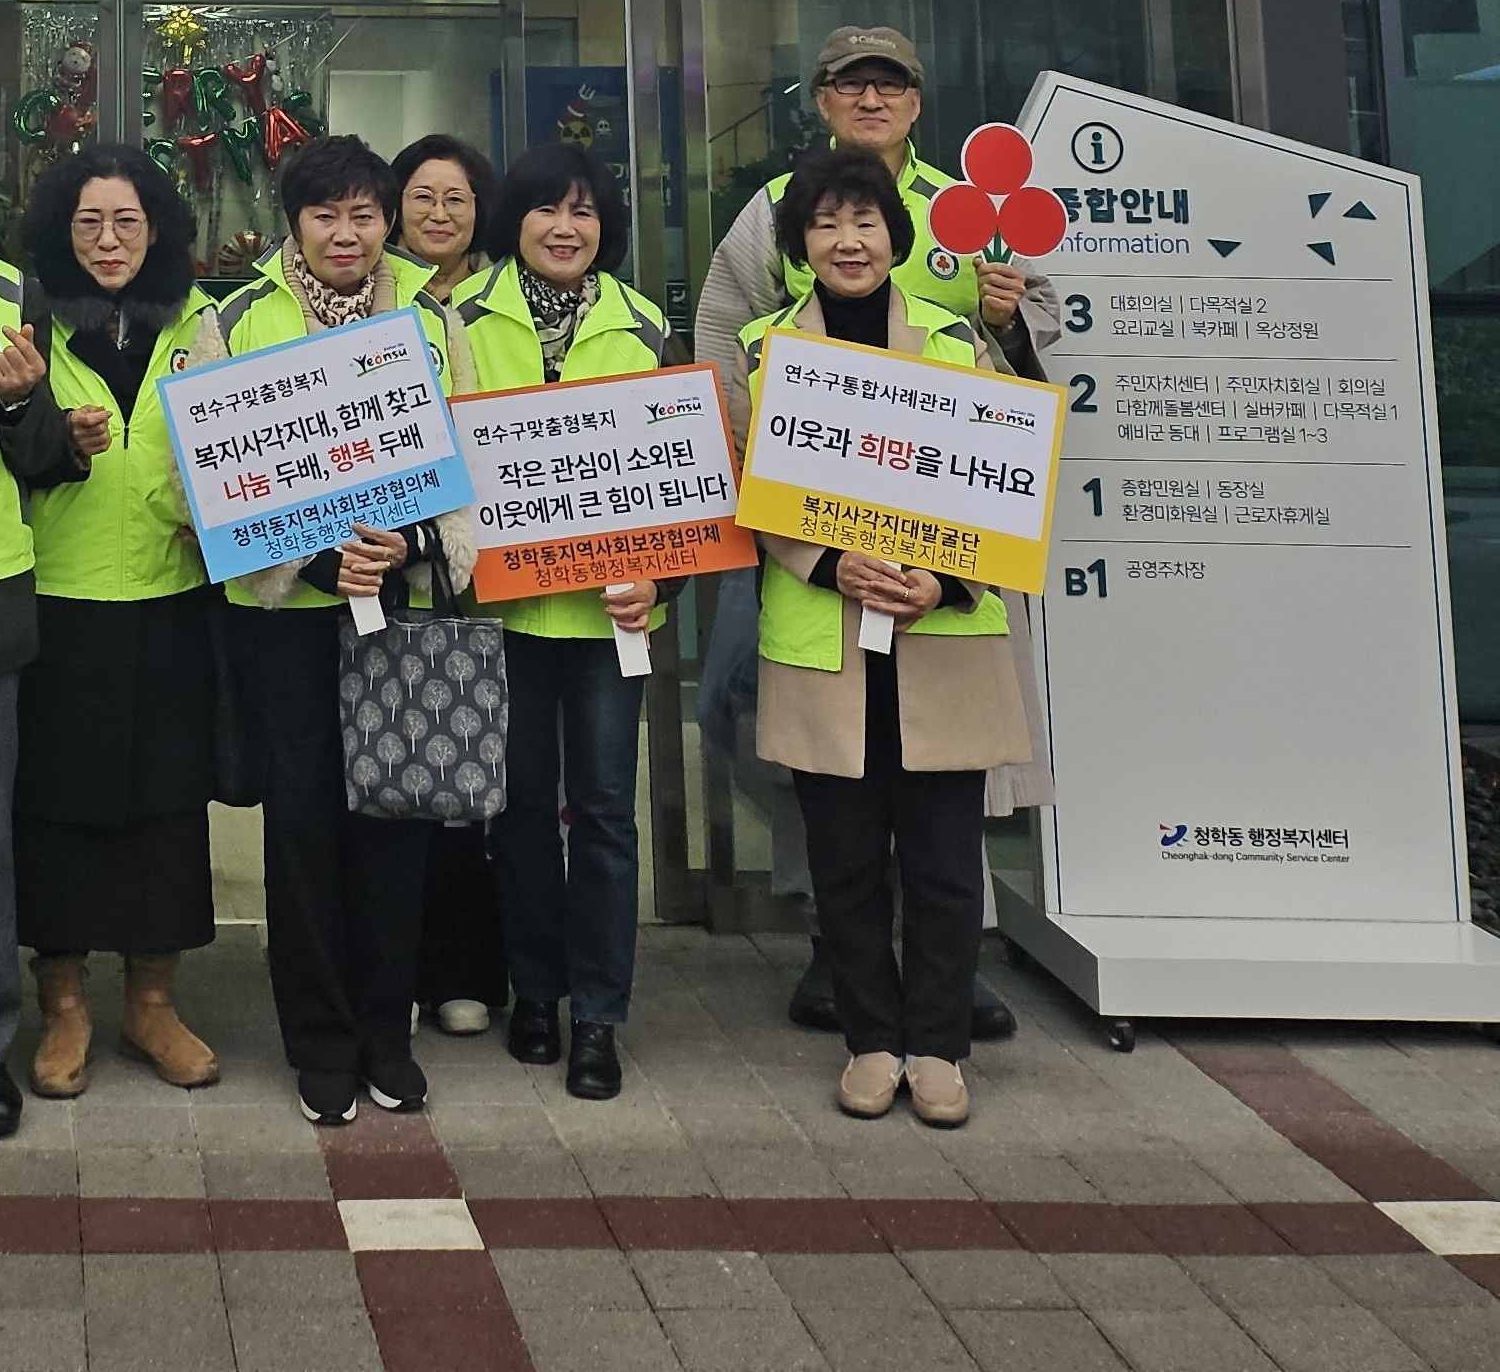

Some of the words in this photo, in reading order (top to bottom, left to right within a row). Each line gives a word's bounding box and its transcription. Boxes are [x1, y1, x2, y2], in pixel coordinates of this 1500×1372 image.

[1057, 231, 1190, 254] nformation
[1065, 294, 1093, 333] 3
[1110, 295, 1173, 314] 대회의실
[1189, 296, 1253, 314] 다목적실
[1256, 298, 1267, 314] 2
[1111, 319, 1174, 338] 요리교실
[1192, 319, 1238, 339] 북카페
[1255, 321, 1319, 340] 옥상정원
[352, 347, 407, 373] Yeonsu
[189, 367, 328, 424] 연수구맞춤형복지
[784, 364, 958, 417] 연수구통합사례관리
[1069, 374, 1098, 413] 2
[1114, 374, 1209, 394] 주민자치센터
[1225, 376, 1321, 395] 주민자치회실
[1337, 378, 1386, 396] 회의실
[1116, 399, 1226, 418] 다함께돌봄센터
[1243, 400, 1306, 420] 실버카페
[1323, 402, 1387, 421] 다목적실
[1389, 404, 1399, 421] 1
[194, 410, 338, 471] 복지사각지대,
[335, 394, 385, 431] 함께
[385, 383, 431, 417] 찾고
[473, 409, 617, 446] 연수구맞춤형복지
[644, 402, 702, 421] Yeonsu
[972, 401, 1035, 427] Yeonsu
[1118, 423, 1166, 442] 예비군
[1168, 425, 1200, 443] 동대
[1217, 426, 1296, 444] 프로그램실
[1299, 428, 1328, 444] 1~3
[223, 471, 272, 504] 나눔
[275, 453, 330, 489] 두배,
[327, 437, 375, 473] 행복
[379, 423, 425, 459] 두배
[497, 460, 547, 490] 작은
[550, 448, 621, 484] 관심이
[626, 438, 696, 472] 소외된
[770, 415, 852, 457] 이웃과
[858, 432, 944, 478] 희망을
[950, 454, 1036, 497] 나눠요
[232, 468, 441, 547] 청학동지역사회보장협의체
[479, 493, 574, 530] 이웃에게
[578, 490, 603, 518] 큰
[606, 483, 654, 515] 힘이
[658, 473, 728, 508] 됩니다
[1082, 477, 1102, 517] 1
[1121, 478, 1200, 498] 종합민원실
[1217, 480, 1265, 499] 동장실
[1122, 503, 1218, 523] 환경미화원실
[1234, 506, 1331, 526] 근로자휴게실
[802, 495, 981, 553] 복지사각지대발굴단
[503, 523, 721, 570] 청학동지역사회보장협의체
[800, 516, 977, 575] 청학동행정복지센터
[535, 548, 698, 588] 청학동행정복지센터
[1065, 558, 1108, 598] B1
[1126, 560, 1206, 580] 공영주차장
[1161, 851, 1234, 862] Cheonghak-dong
[1236, 852, 1284, 863] Community
[1286, 853, 1319, 863] Service
[1321, 854, 1350, 863] Center
[1194, 826, 1244, 847] 청학동
[1248, 828, 1349, 849] 행정복지센터
